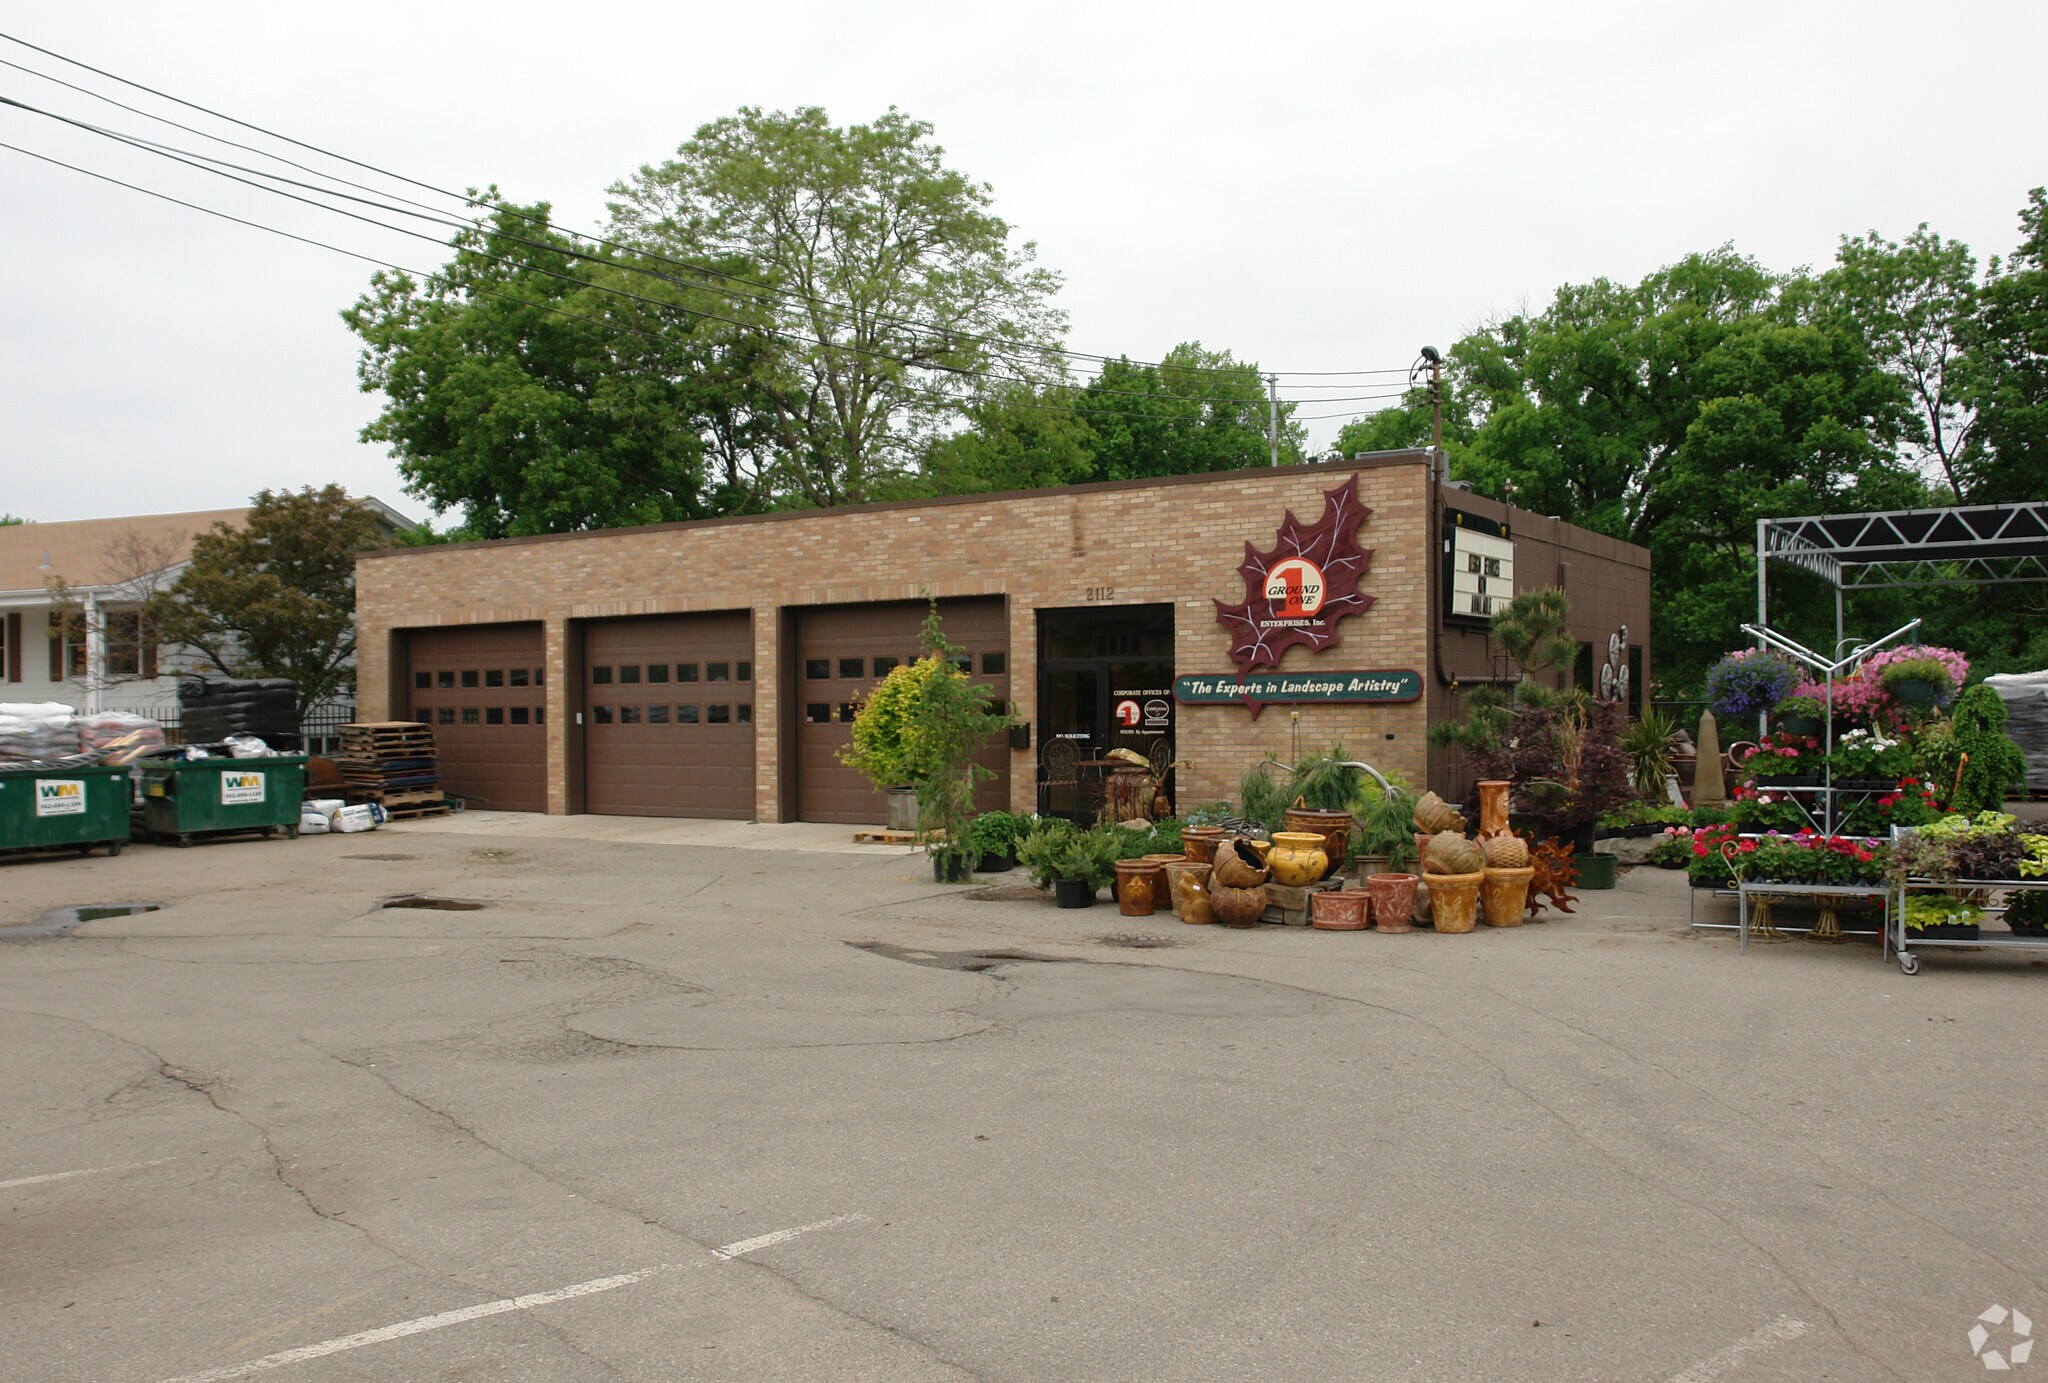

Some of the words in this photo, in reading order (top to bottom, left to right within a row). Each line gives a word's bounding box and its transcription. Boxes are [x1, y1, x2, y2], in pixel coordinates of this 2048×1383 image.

[1086, 586, 1115, 601] 2112
[1268, 584, 1320, 596] GROUND
[1289, 595, 1316, 605] ONE
[1312, 618, 1327, 626] Inc.
[1215, 679, 1262, 697] Experts
[1265, 680, 1277, 693] in
[1280, 679, 1344, 697] Landscape
[225, 775, 260, 788] WM
[40, 784, 79, 797] WM
